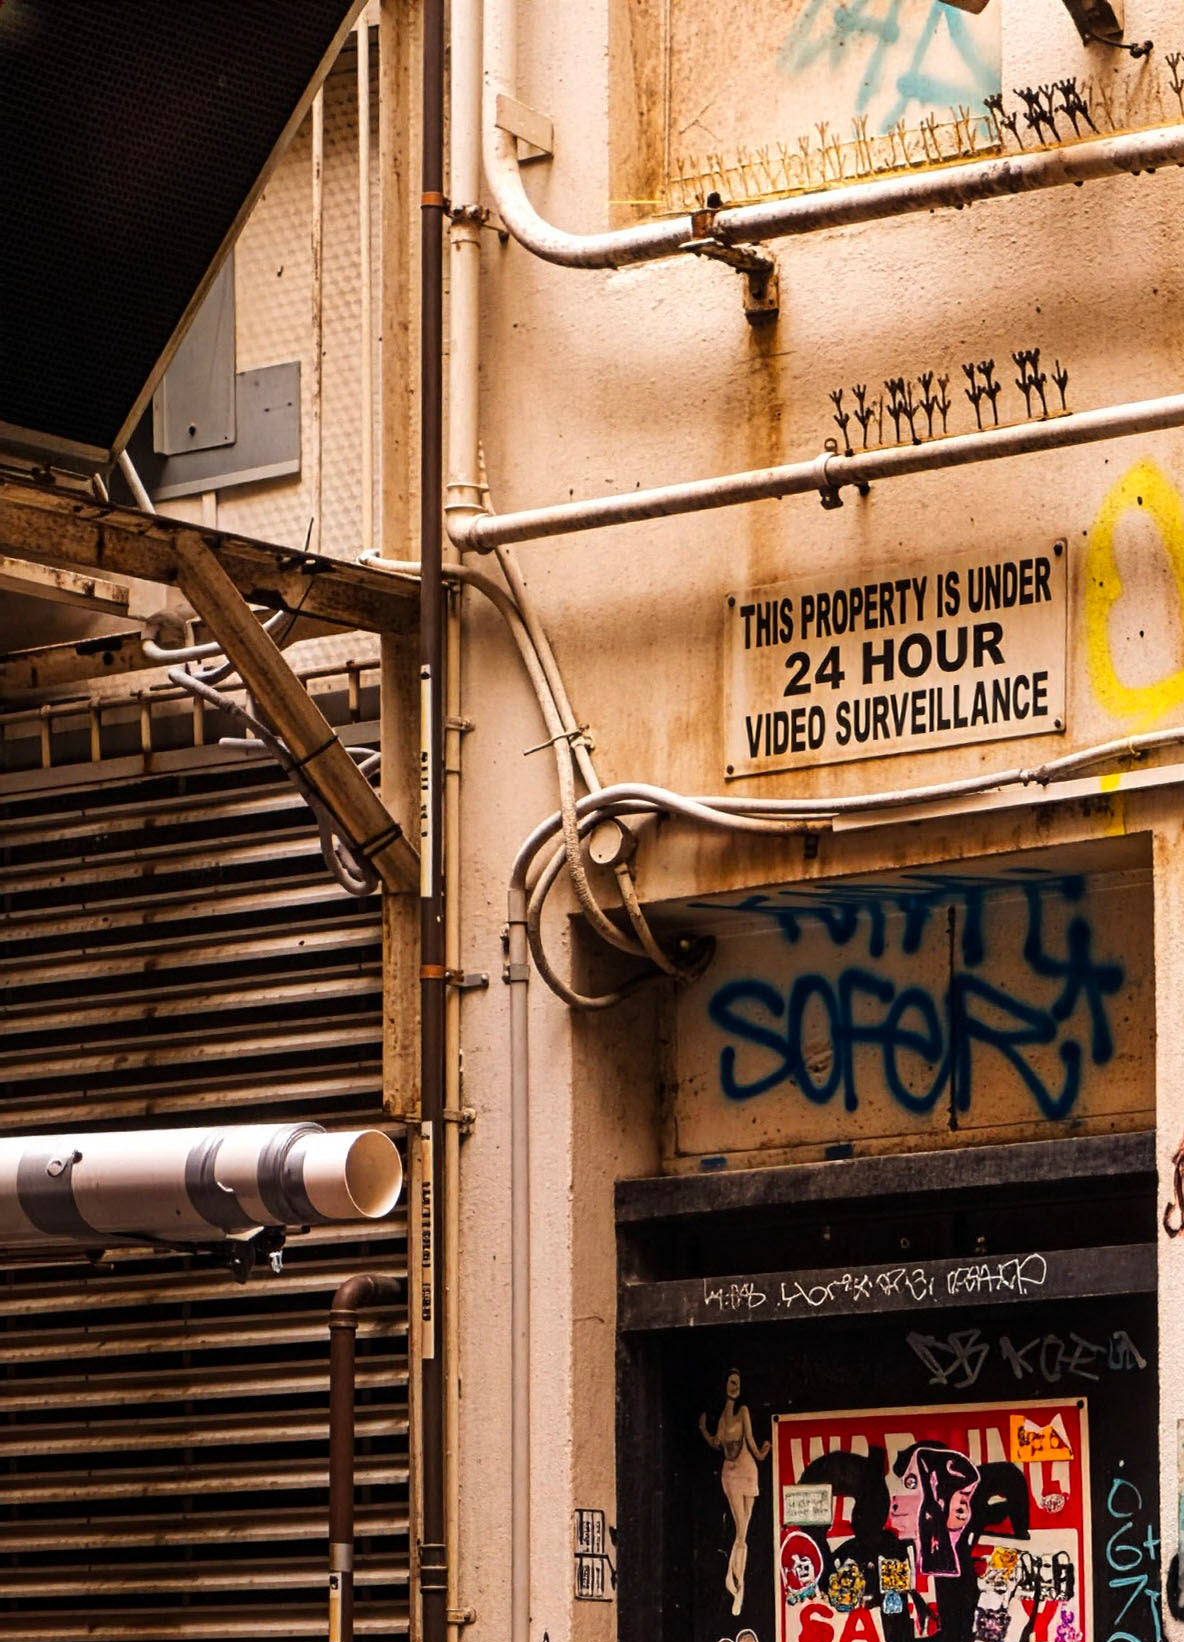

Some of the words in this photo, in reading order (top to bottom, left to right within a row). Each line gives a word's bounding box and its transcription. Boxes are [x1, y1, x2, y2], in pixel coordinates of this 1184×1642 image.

[740, 598, 794, 650] THIS
[801, 576, 928, 640] PROPERTY
[936, 570, 960, 618] IS
[967, 557, 1052, 613] UNDER
[783, 645, 845, 697] 24
[863, 621, 1006, 685] HOUR
[745, 705, 825, 758] VIDEO
[835, 671, 1049, 746] SURVEILLANCE
